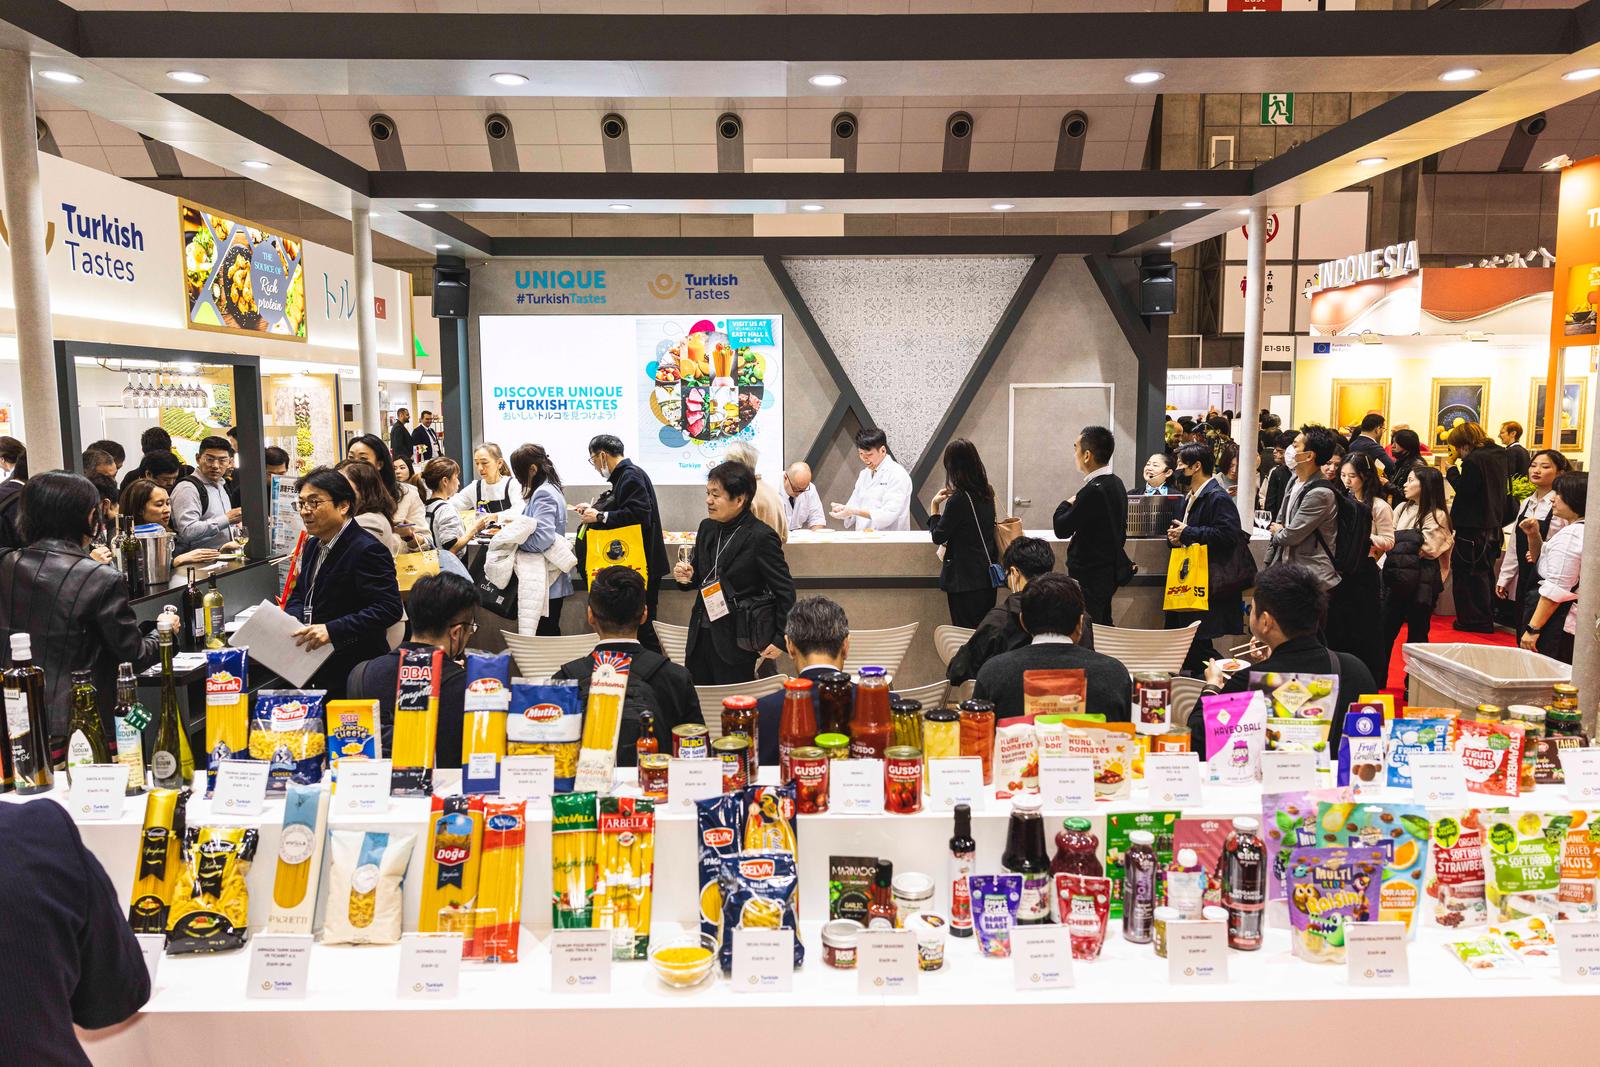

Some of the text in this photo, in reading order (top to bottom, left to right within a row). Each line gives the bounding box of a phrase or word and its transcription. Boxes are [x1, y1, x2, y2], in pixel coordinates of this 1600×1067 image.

[62, 203, 144, 251] Turkish
[65, 240, 135, 282] Tastes
[262, 252, 273, 261] THE
[254, 261, 275, 274] SOURCE
[1318, 240, 1419, 289] INDONESIA
[260, 276, 279, 295] Rich
[515, 270, 607, 289] UNIQUE
[685, 273, 739, 286] Turkish
[516, 293, 607, 304] #TurkishTastes
[685, 287, 731, 300] Tastes
[257, 299, 283, 315] protein
[493, 386, 623, 398] DISCOVER UNIQUE
[498, 399, 618, 411] #TURKISHTASTES
[400, 666, 432, 680] OBA
[206, 681, 240, 691] Berrak
[275, 708, 306, 719] Berrak
[1214, 726, 1235, 736] HAVE
[1244, 722, 1262, 732] BALL
[1465, 749, 1493, 761] FRUIT
[1462, 758, 1496, 769] STRIPS
[1505, 731, 1520, 796] STRAWBERRY
[794, 765, 827, 776] GUSDO
[888, 765, 921, 775] GUSDO
[605, 817, 649, 829] ARBELLA
[1200, 821, 1219, 829] elite
[1565, 834, 1585, 843] ANIC
[1237, 848, 1260, 860] elite
[1450, 848, 1468, 859] SOFT
[1519, 844, 1546, 854] ORGANIC
[1508, 855, 1553, 867] SOFT DRIED
[1562, 858, 1593, 869] ICOTS
[1315, 866, 1352, 880] MULTI
[1521, 867, 1546, 880] FIGS
